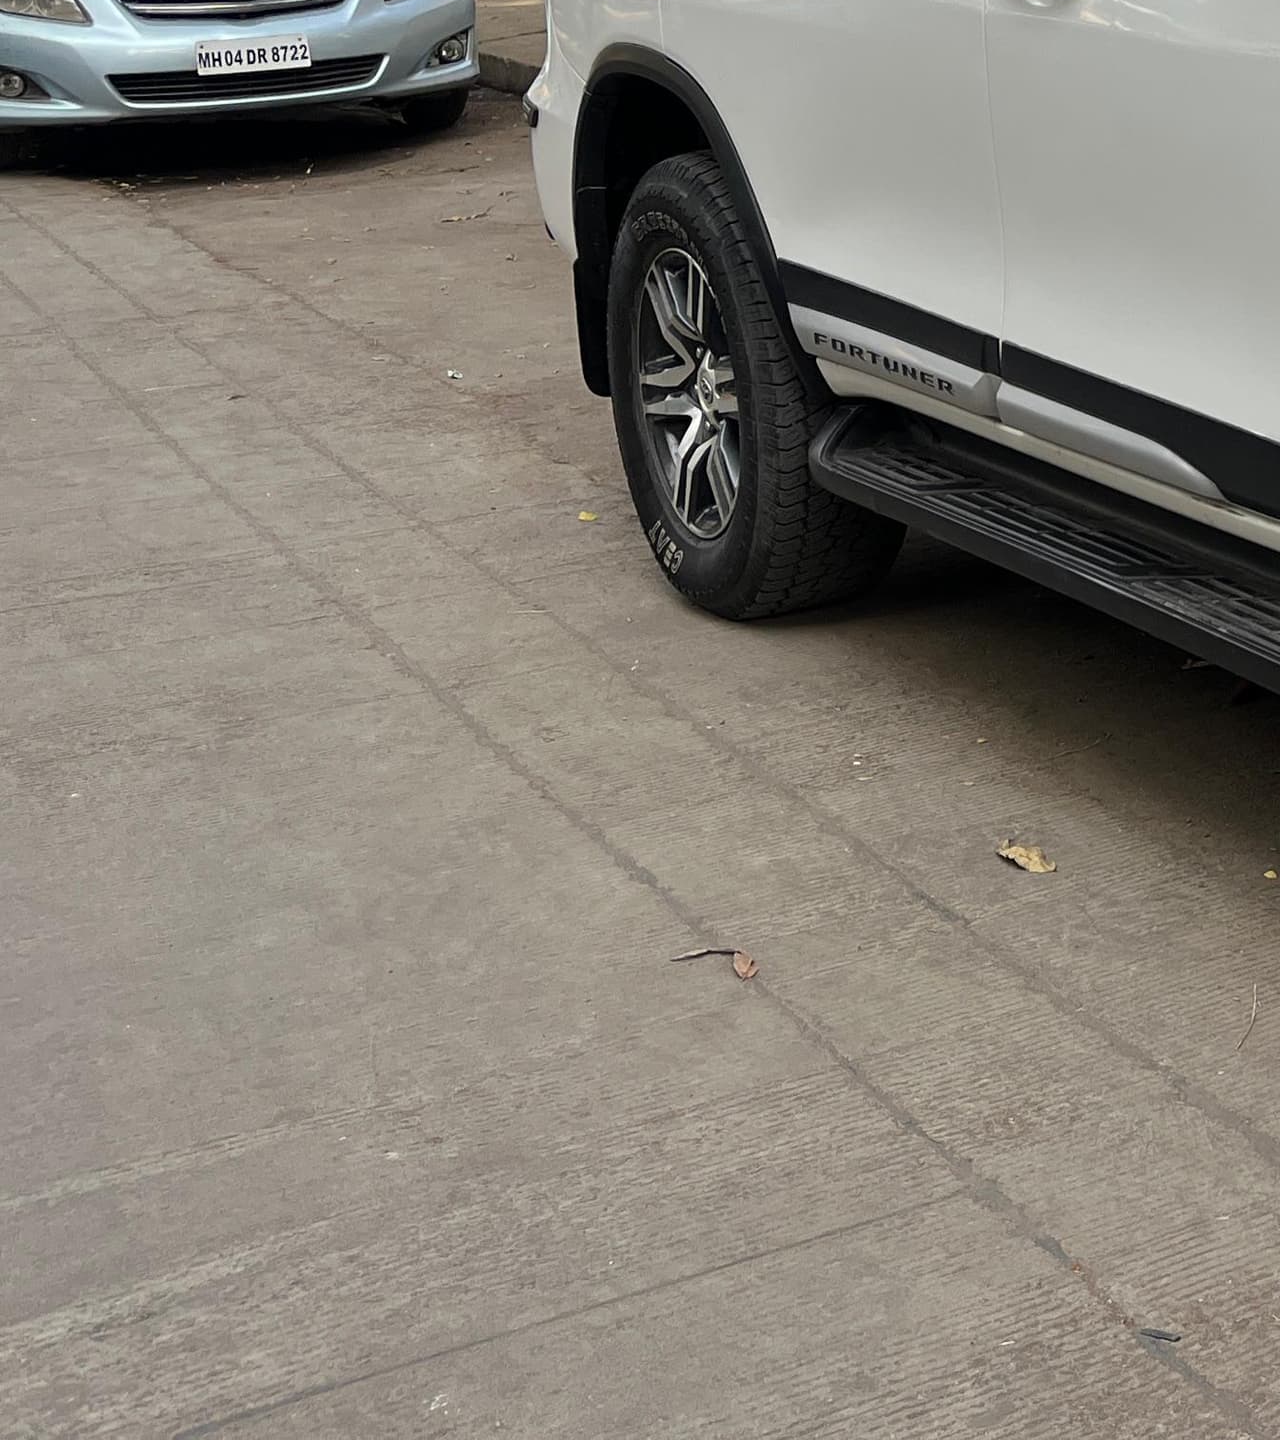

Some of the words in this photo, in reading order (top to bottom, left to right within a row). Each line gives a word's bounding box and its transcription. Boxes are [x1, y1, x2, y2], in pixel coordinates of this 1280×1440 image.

[246, 48, 268, 65] DR
[271, 43, 309, 63] 8722
[813, 331, 955, 397] FORTUNER
